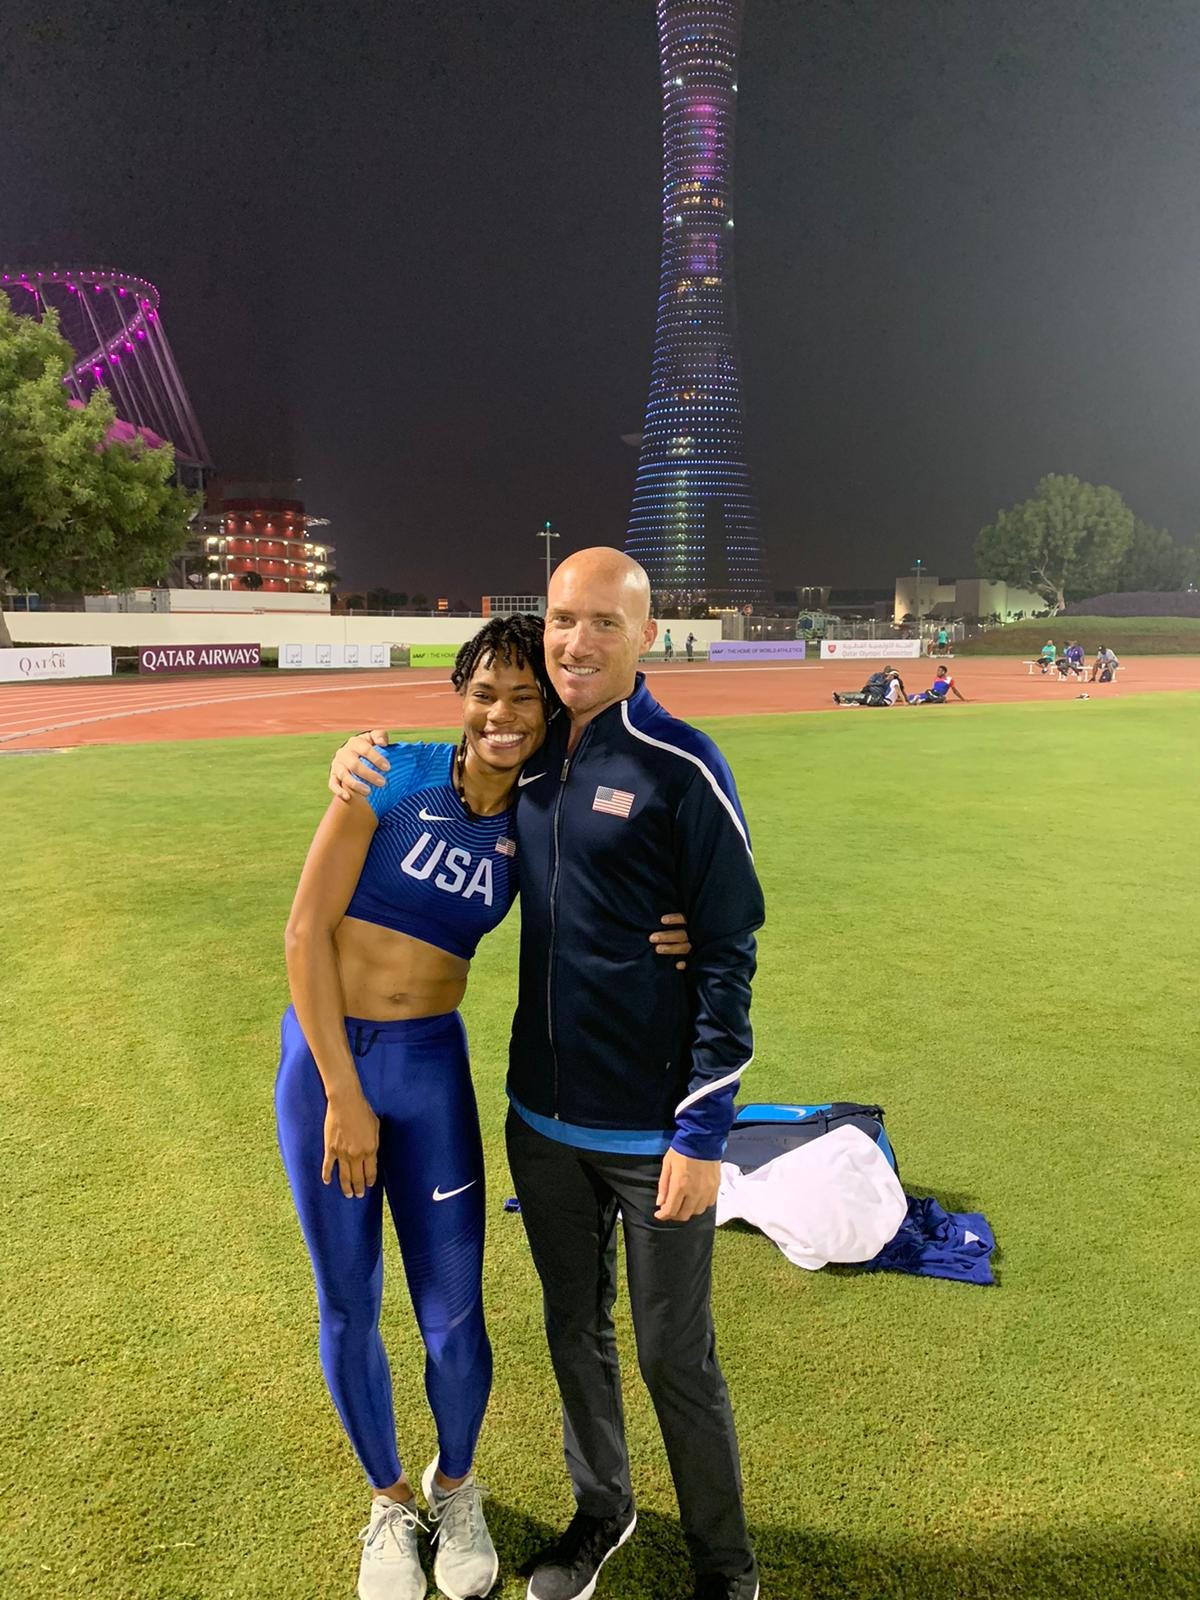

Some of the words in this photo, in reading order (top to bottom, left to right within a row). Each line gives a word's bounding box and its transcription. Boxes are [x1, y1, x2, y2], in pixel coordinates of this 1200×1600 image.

[19, 656, 66, 676] QATAR
[142, 650, 195, 670] QATAR
[198, 648, 259, 665] AIRWAYS
[400, 831, 494, 907] USA
